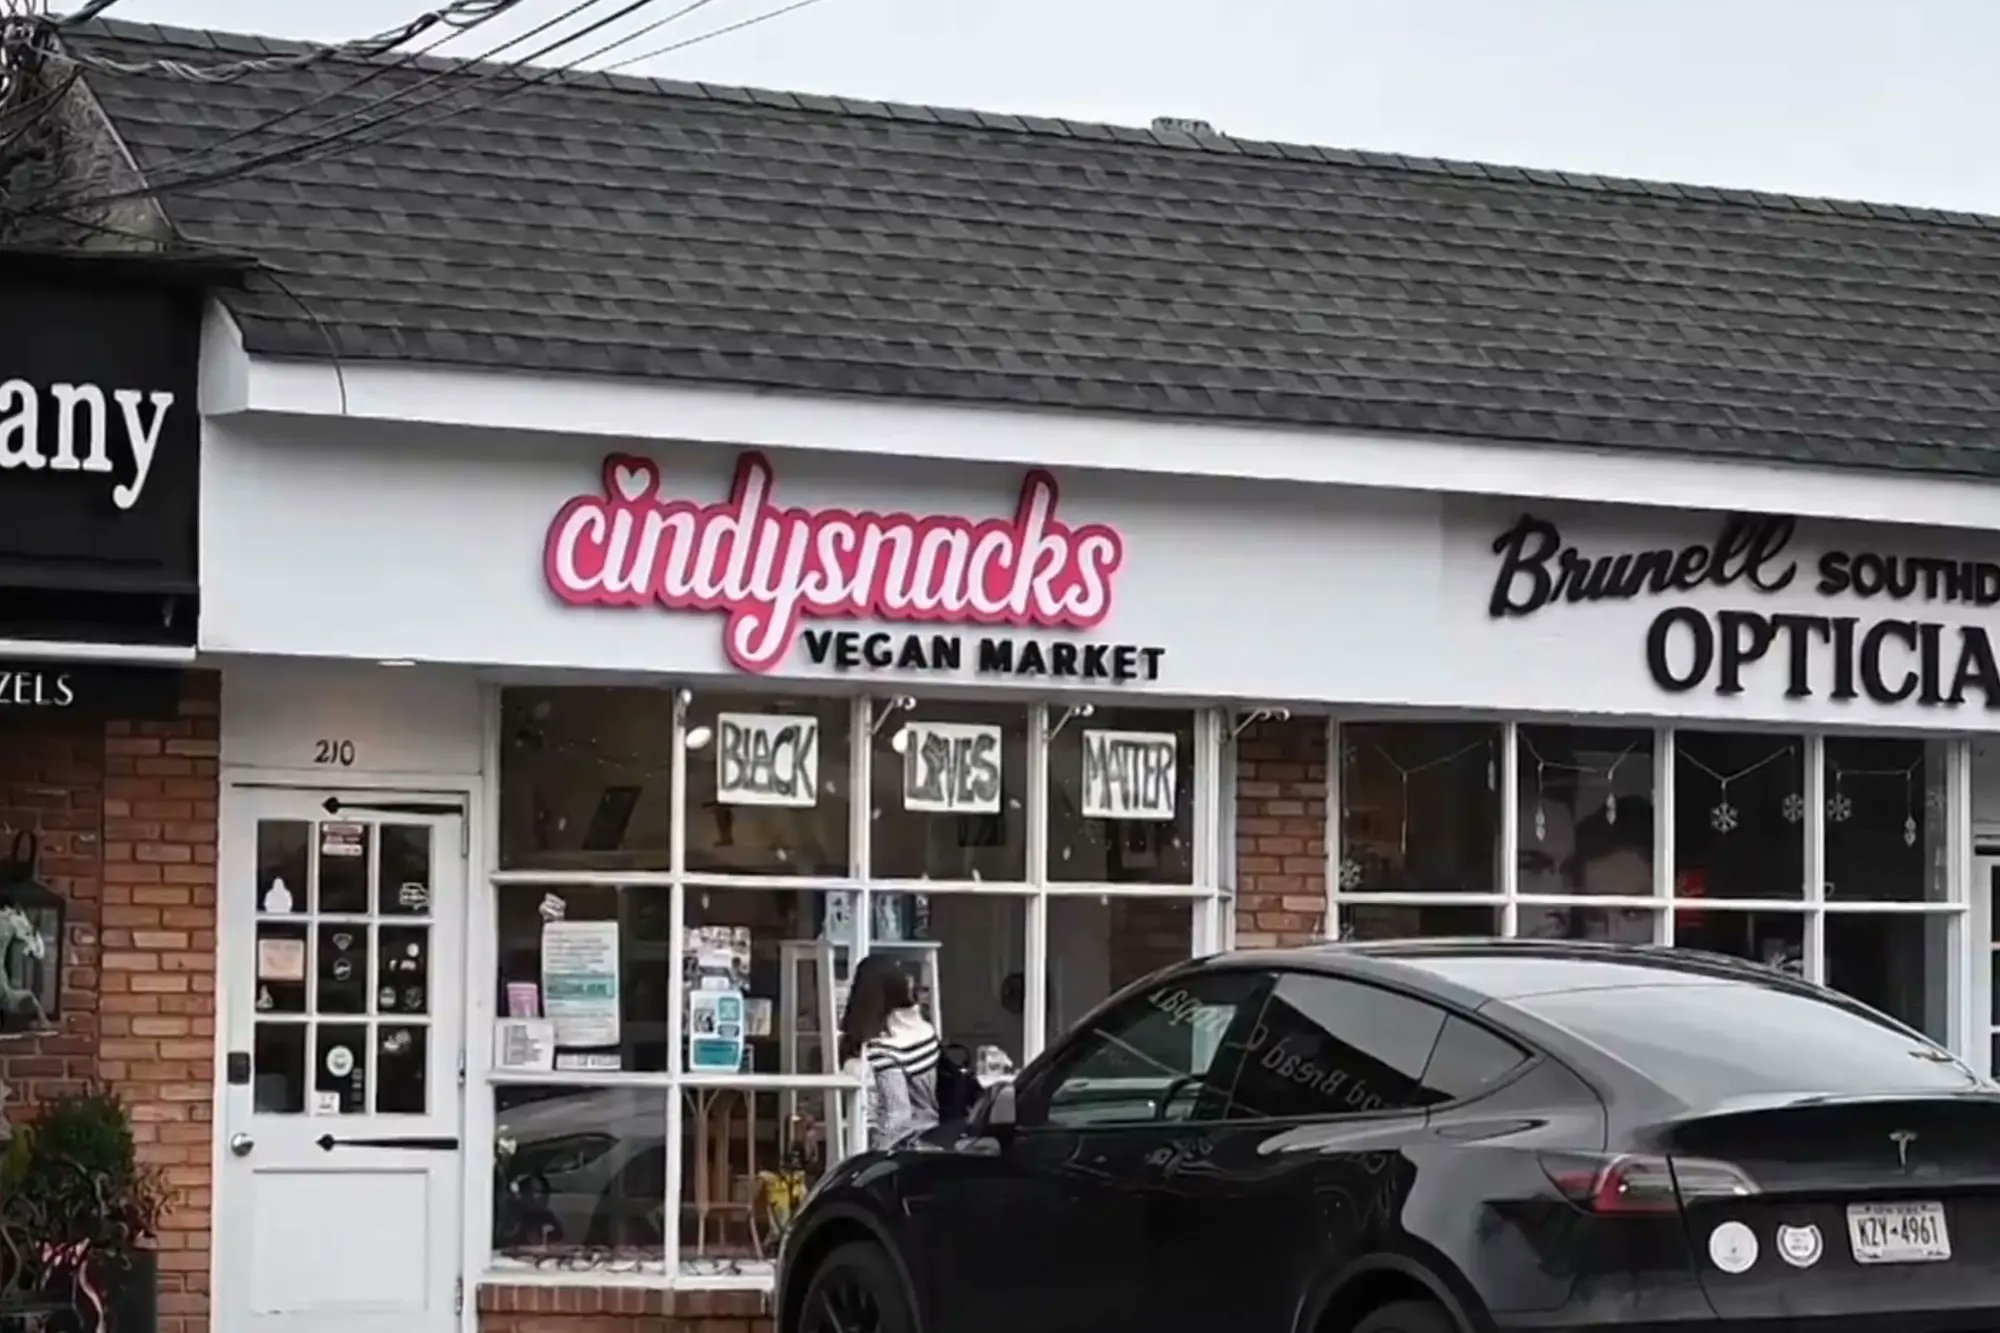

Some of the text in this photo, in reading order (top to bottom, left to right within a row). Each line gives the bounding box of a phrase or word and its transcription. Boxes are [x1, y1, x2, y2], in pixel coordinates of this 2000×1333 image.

[0, 378, 175, 509] any
[552, 456, 1118, 667] cindysnacks
[1490, 513, 2000, 618] Brunell SOUTHD
[803, 629, 1166, 681] VEGAN MARKET
[1647, 606, 2000, 709] OPTICIA
[313, 739, 356, 767] 210
[721, 720, 816, 799] BLACK
[1083, 735, 1174, 811] MATTER
